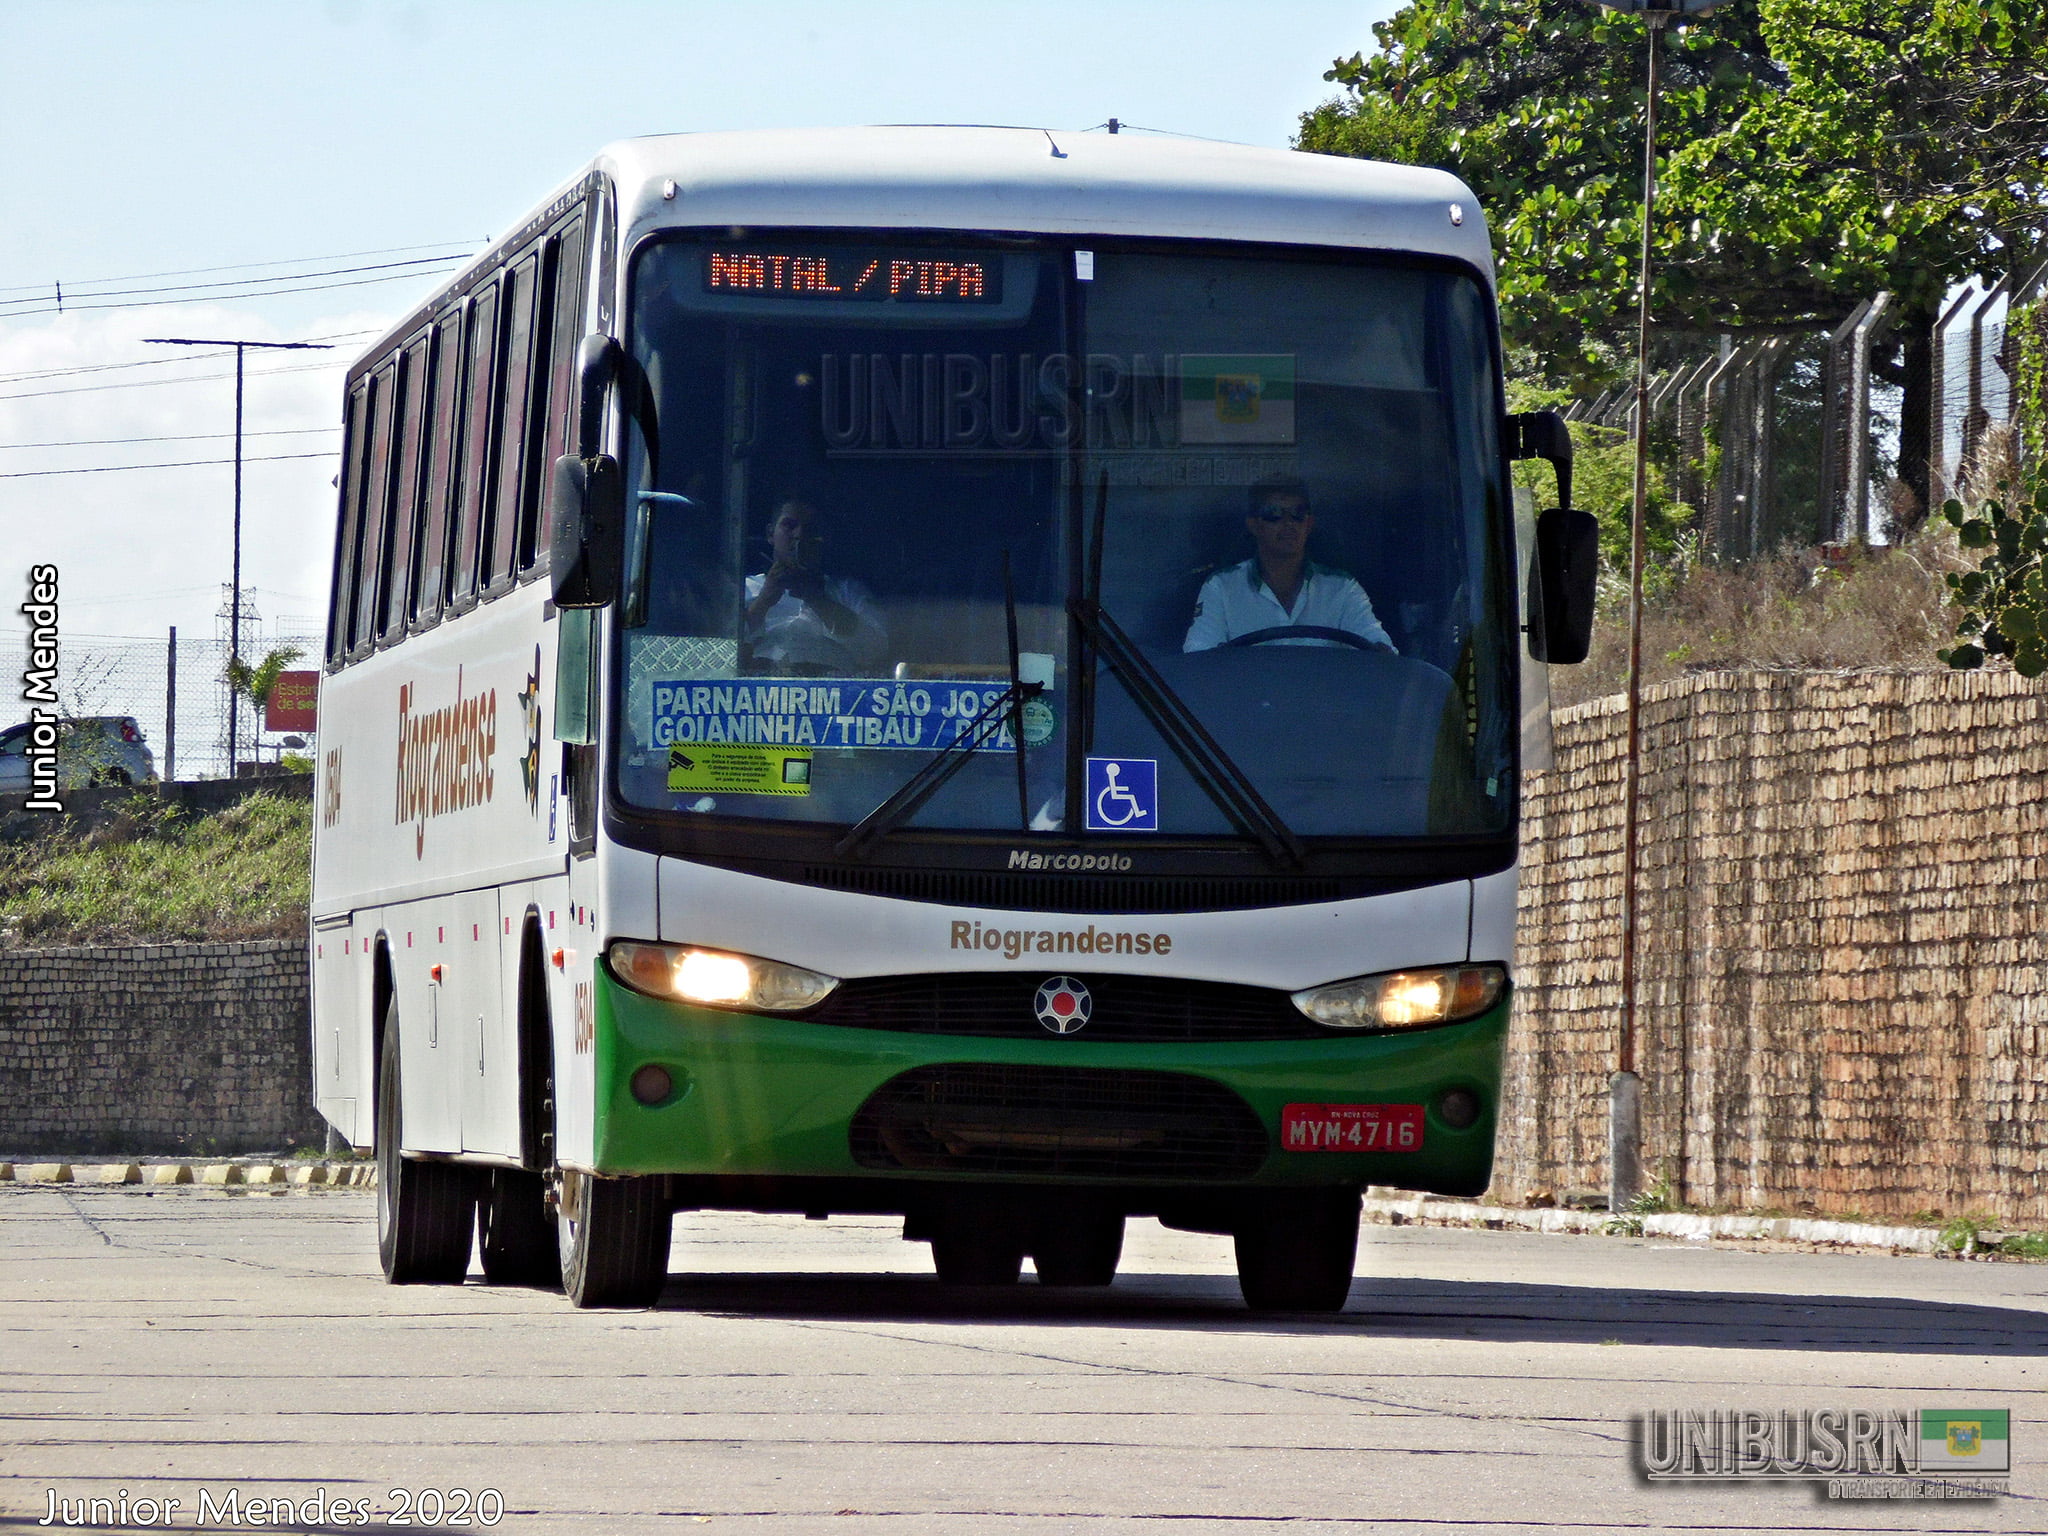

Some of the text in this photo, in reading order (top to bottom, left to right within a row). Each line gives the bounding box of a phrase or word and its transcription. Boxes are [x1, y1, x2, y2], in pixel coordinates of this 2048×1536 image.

[712, 253, 840, 290] NATAL
[890, 260, 984, 297] PIPA
[656, 686, 840, 716] PARNAMIRIM
[872, 684, 931, 717] SÃO
[654, 715, 815, 744] GOIANINHA
[837, 716, 922, 746] TIBAU
[395, 664, 496, 861] Riograndense
[1008, 850, 1132, 871] Marcopolo
[950, 920, 1172, 960] Riograndense
[575, 980, 594, 1055] 0504
